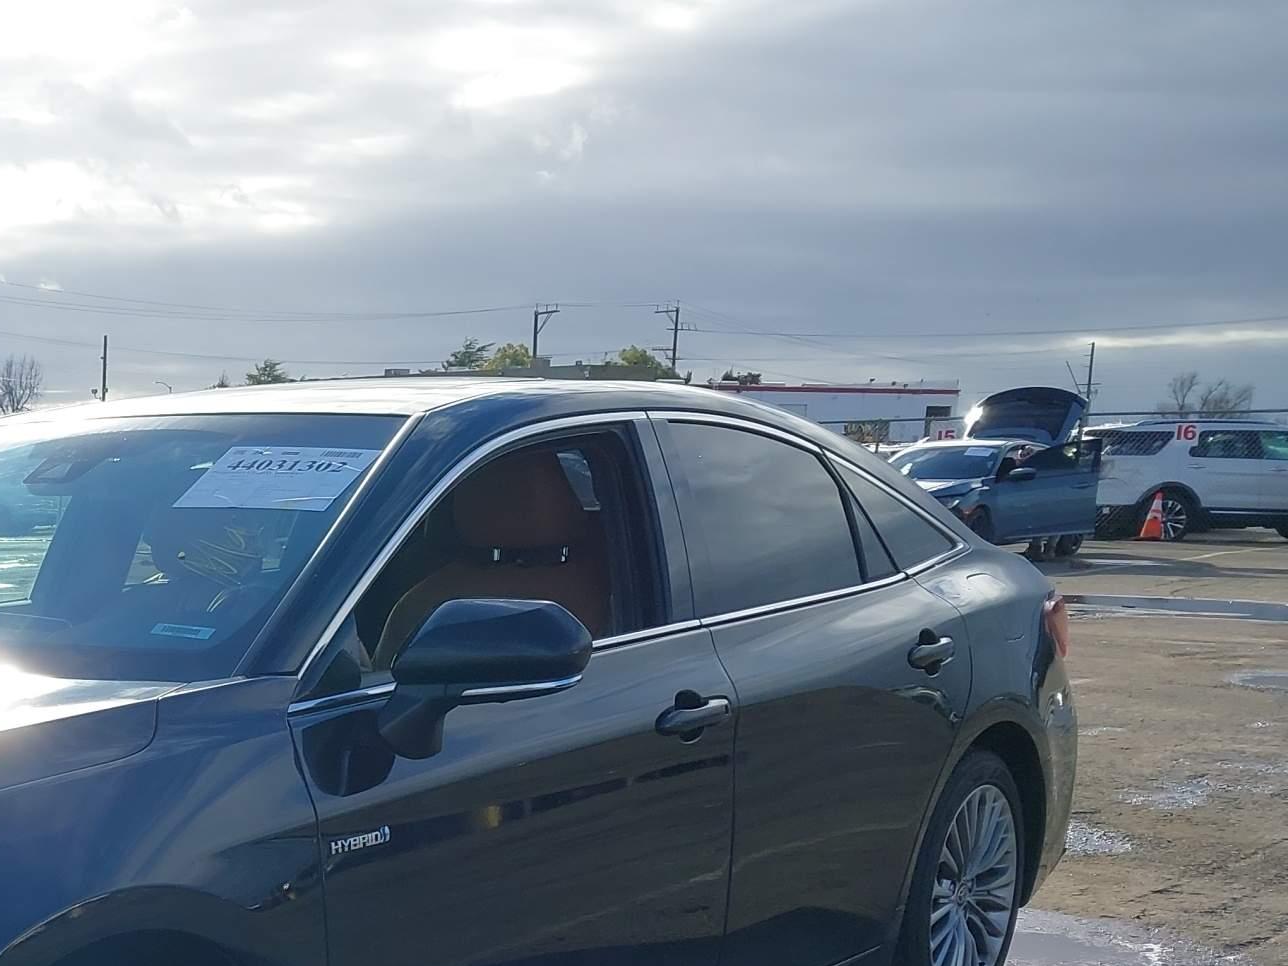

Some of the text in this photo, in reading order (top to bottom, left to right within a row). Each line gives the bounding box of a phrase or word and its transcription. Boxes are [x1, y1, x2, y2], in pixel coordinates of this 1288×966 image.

[1176, 424, 1197, 441] 16
[227, 459, 348, 473] 44031302
[330, 831, 381, 855] HYBRID
